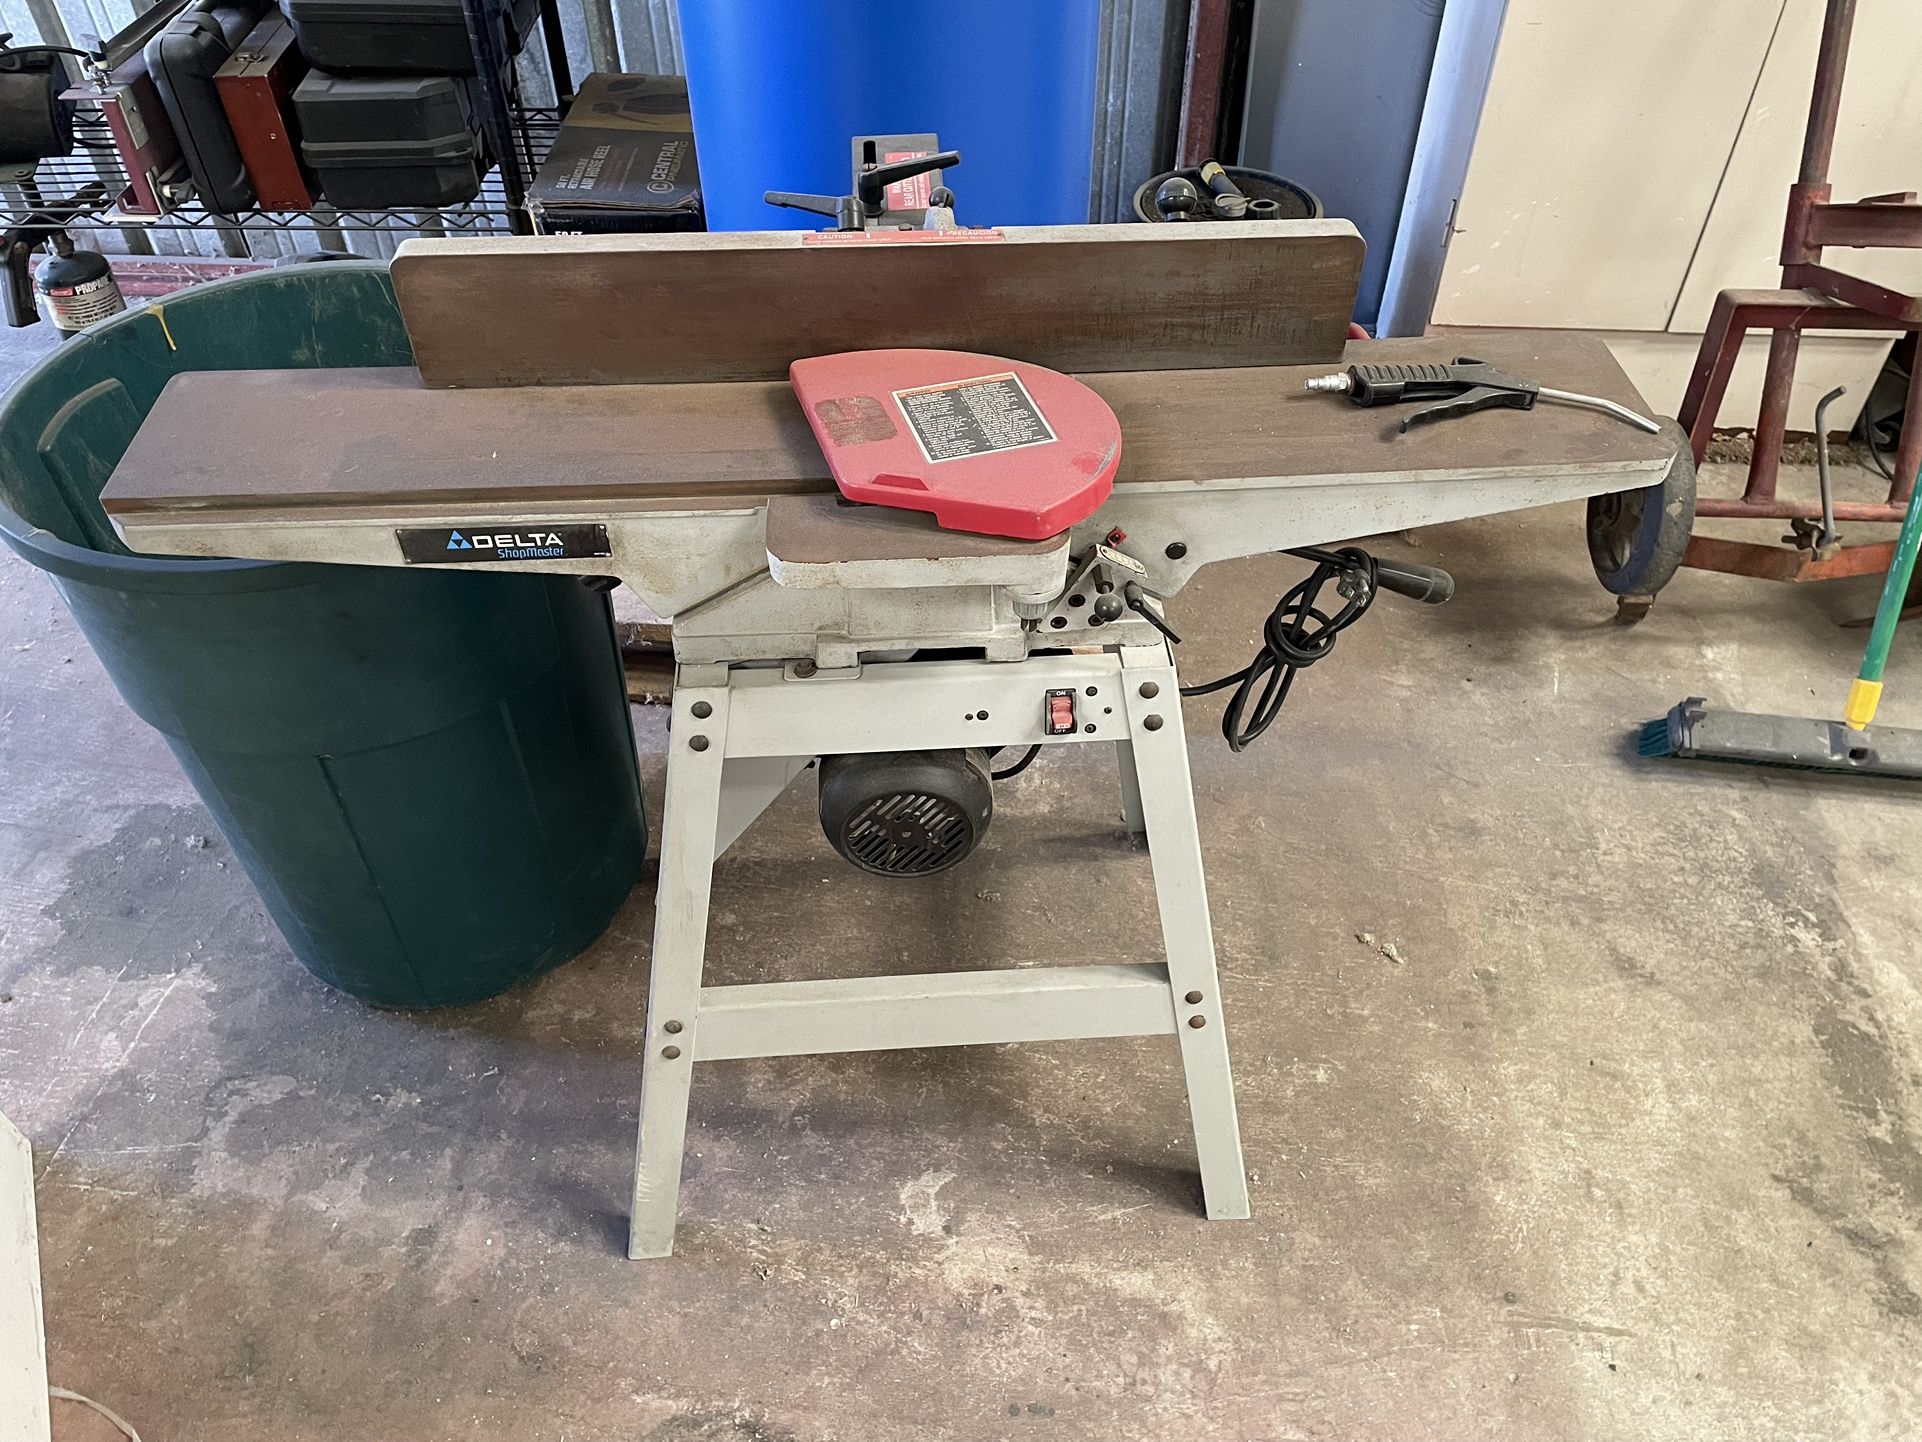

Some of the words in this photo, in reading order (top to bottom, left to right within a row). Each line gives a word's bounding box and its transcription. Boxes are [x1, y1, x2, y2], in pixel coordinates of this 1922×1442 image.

[592, 145, 611, 159] REEL
[583, 159, 605, 177] HOSE
[650, 141, 679, 181] CENTRAL
[579, 177, 597, 190] AIR
[471, 532, 564, 549] DELTA
[497, 547, 564, 560] ShopMaster
